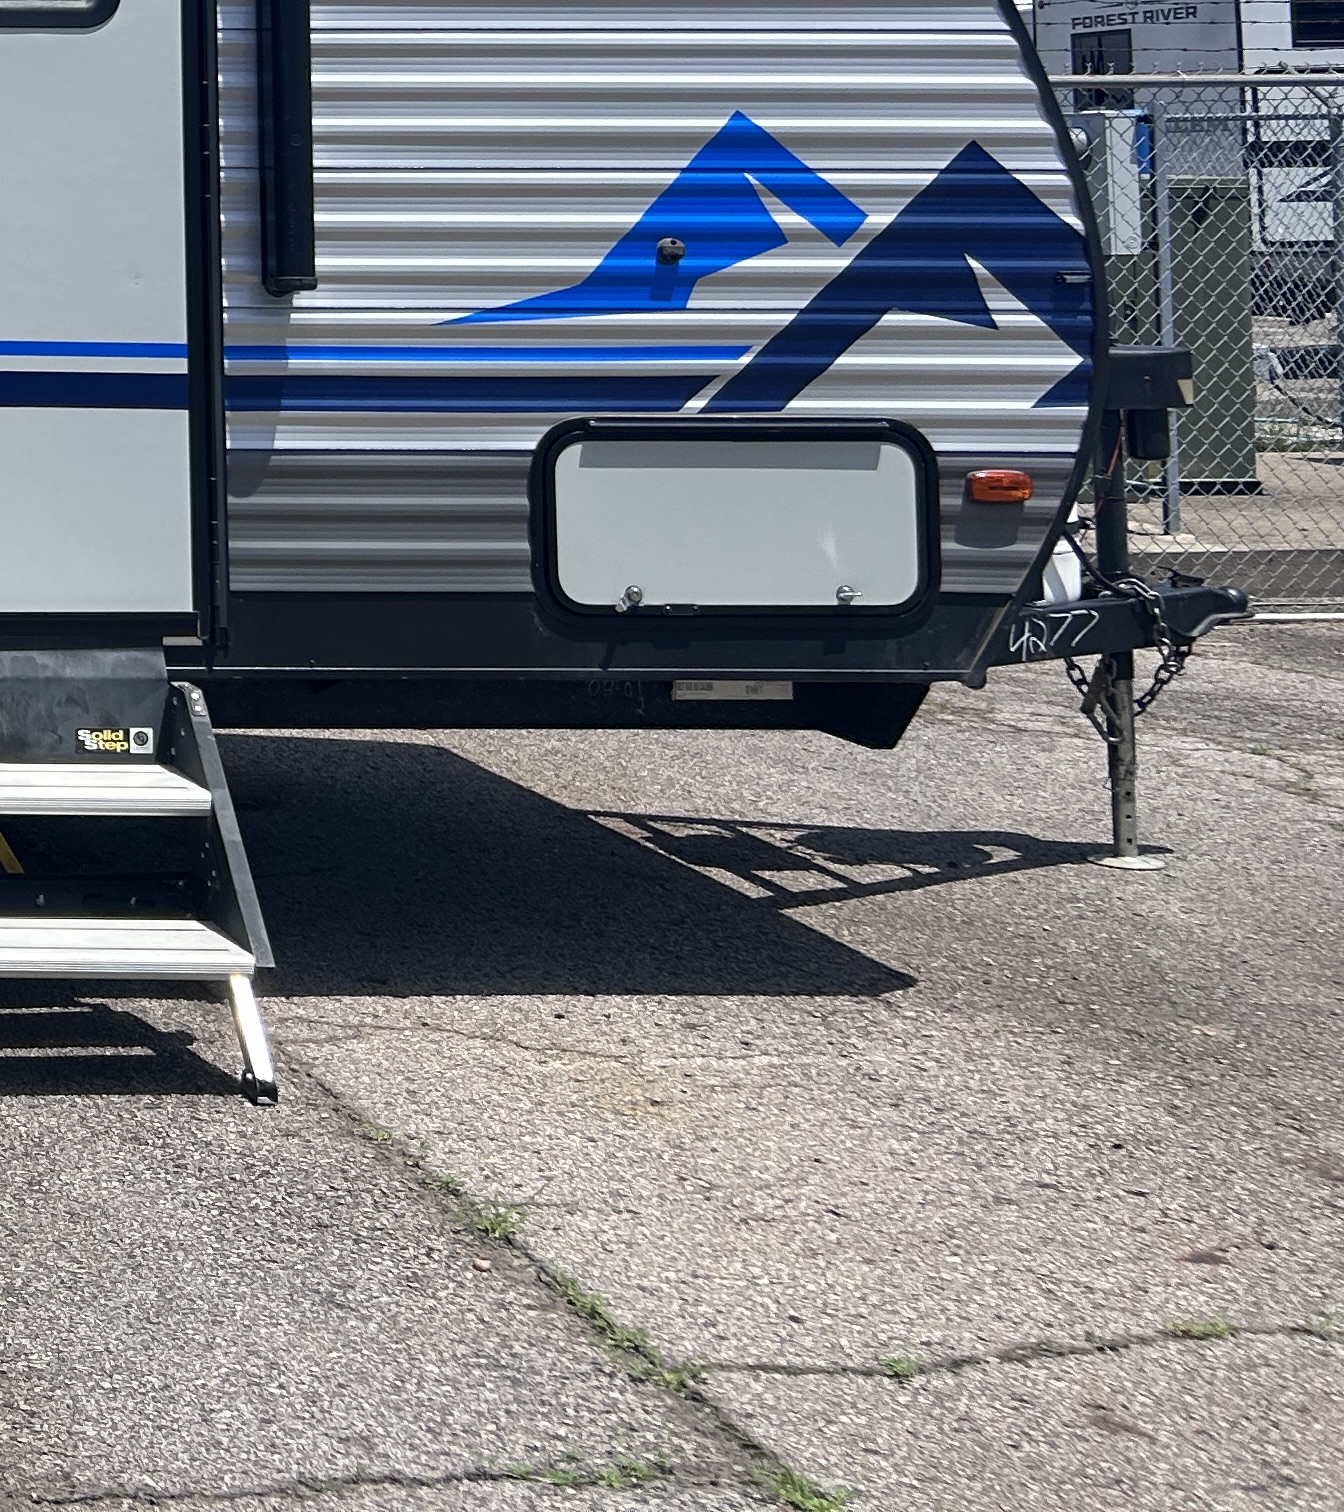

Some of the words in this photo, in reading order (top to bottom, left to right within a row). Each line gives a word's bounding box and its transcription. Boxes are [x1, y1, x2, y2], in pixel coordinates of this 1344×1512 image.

[1070, 11, 1139, 30] FOREST
[1142, 5, 1198, 24] RIVER
[77, 729, 124, 741] Solid
[83, 739, 129, 753] Step
